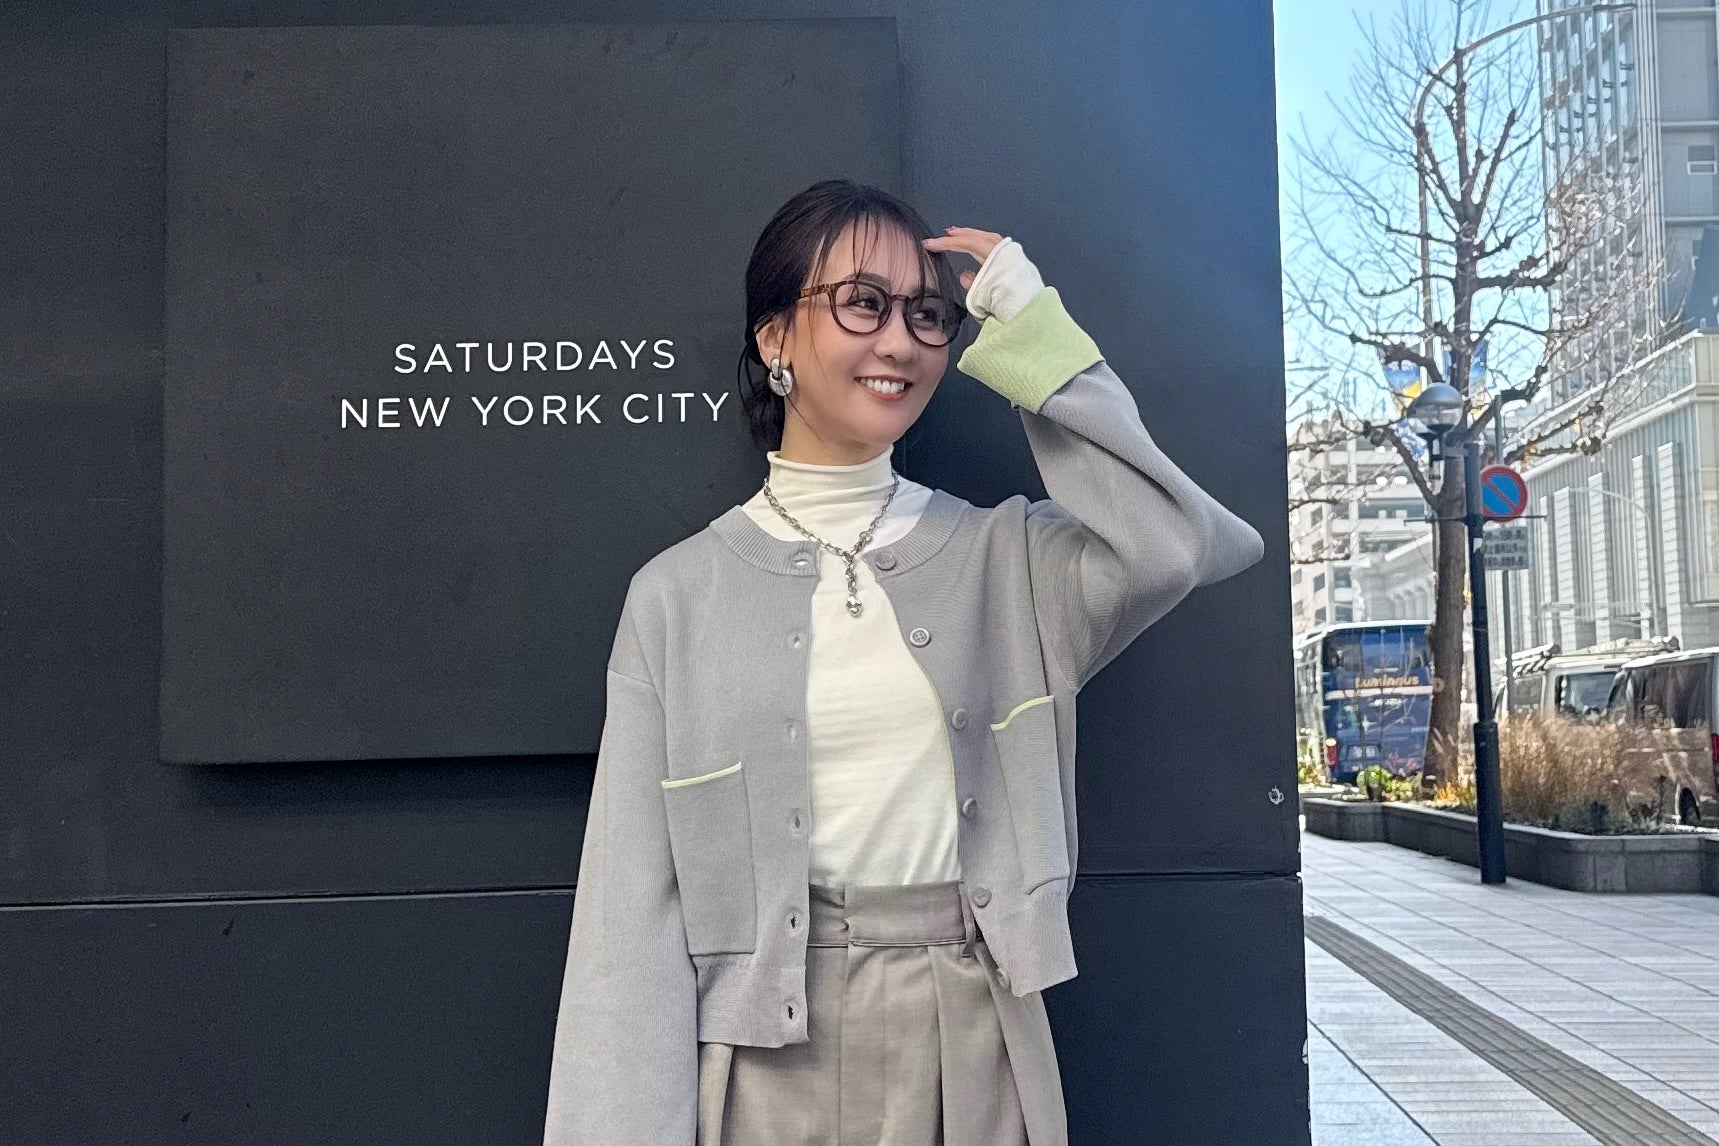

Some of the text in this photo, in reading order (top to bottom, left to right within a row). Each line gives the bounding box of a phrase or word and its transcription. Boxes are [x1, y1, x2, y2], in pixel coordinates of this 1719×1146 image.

[394, 339, 675, 374] SATURDAYS
[341, 391, 730, 429] NEW YORK CITY
